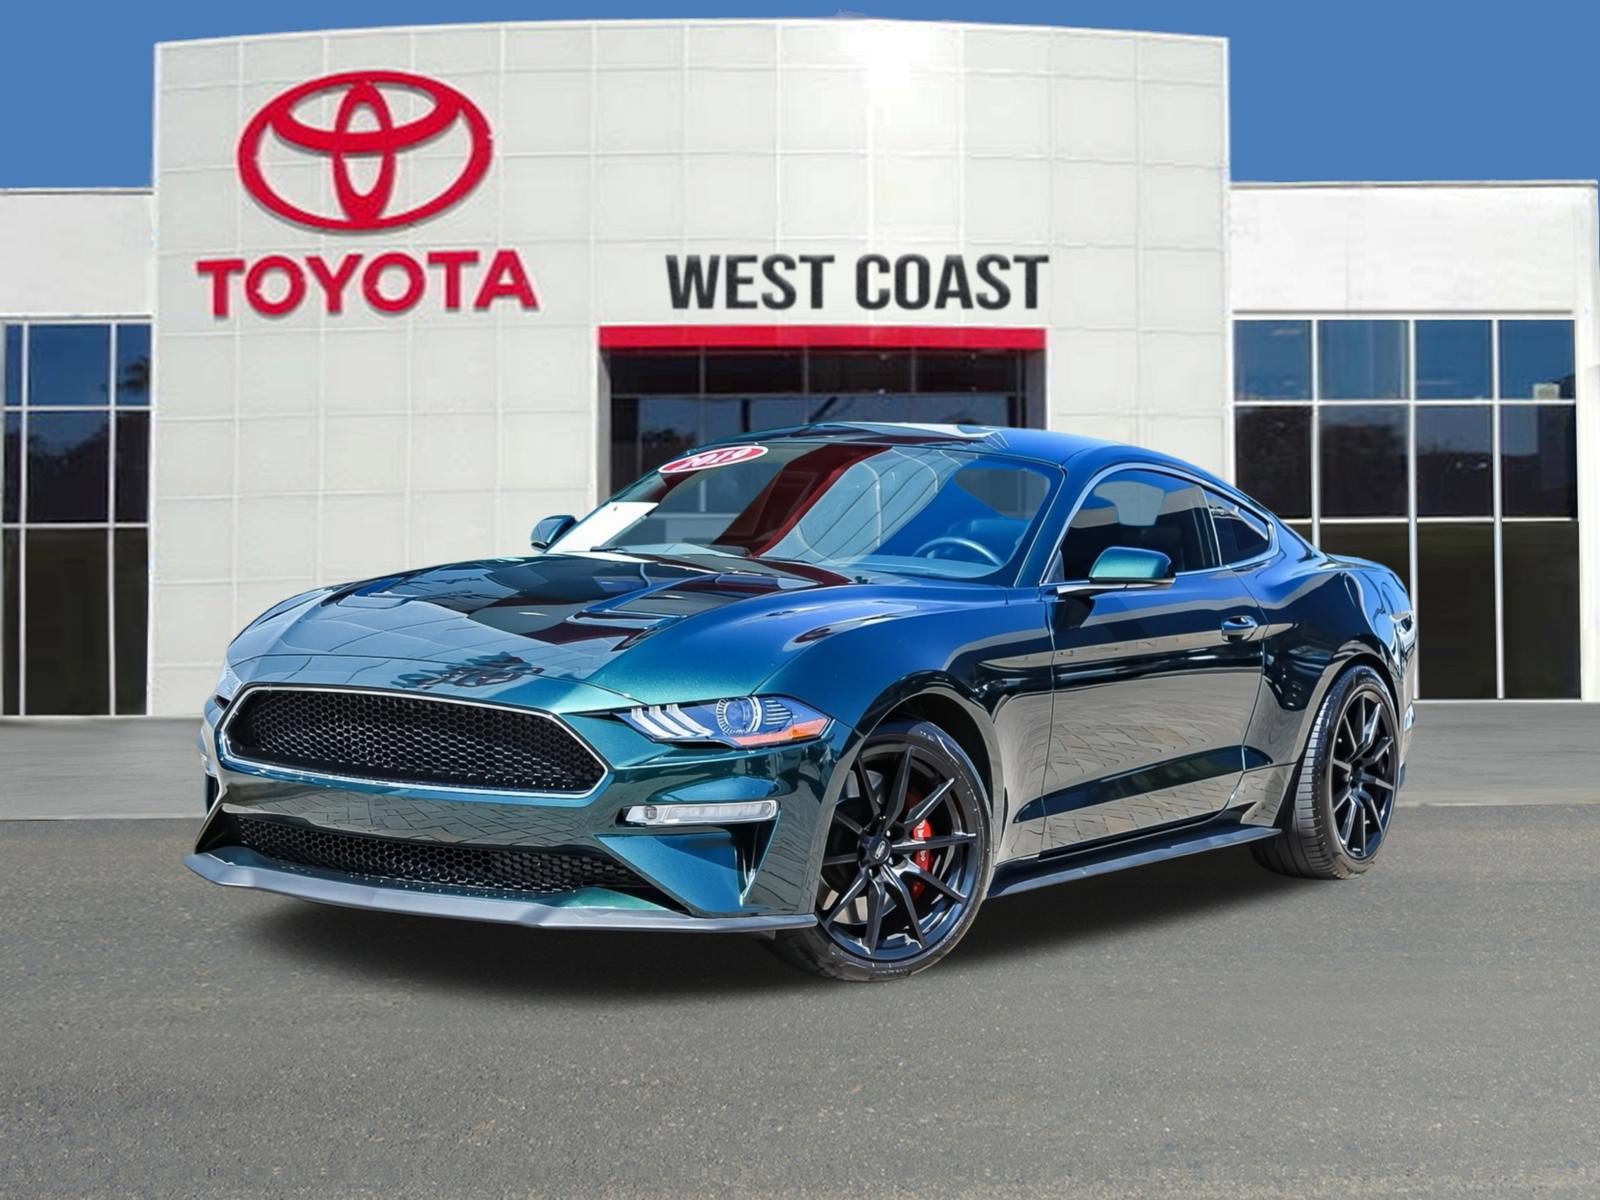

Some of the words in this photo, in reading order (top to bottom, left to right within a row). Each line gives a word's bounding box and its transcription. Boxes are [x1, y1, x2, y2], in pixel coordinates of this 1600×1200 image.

[197, 249, 539, 320] TOYOTA
[666, 253, 835, 311] WEST
[855, 253, 1049, 311] COAST
